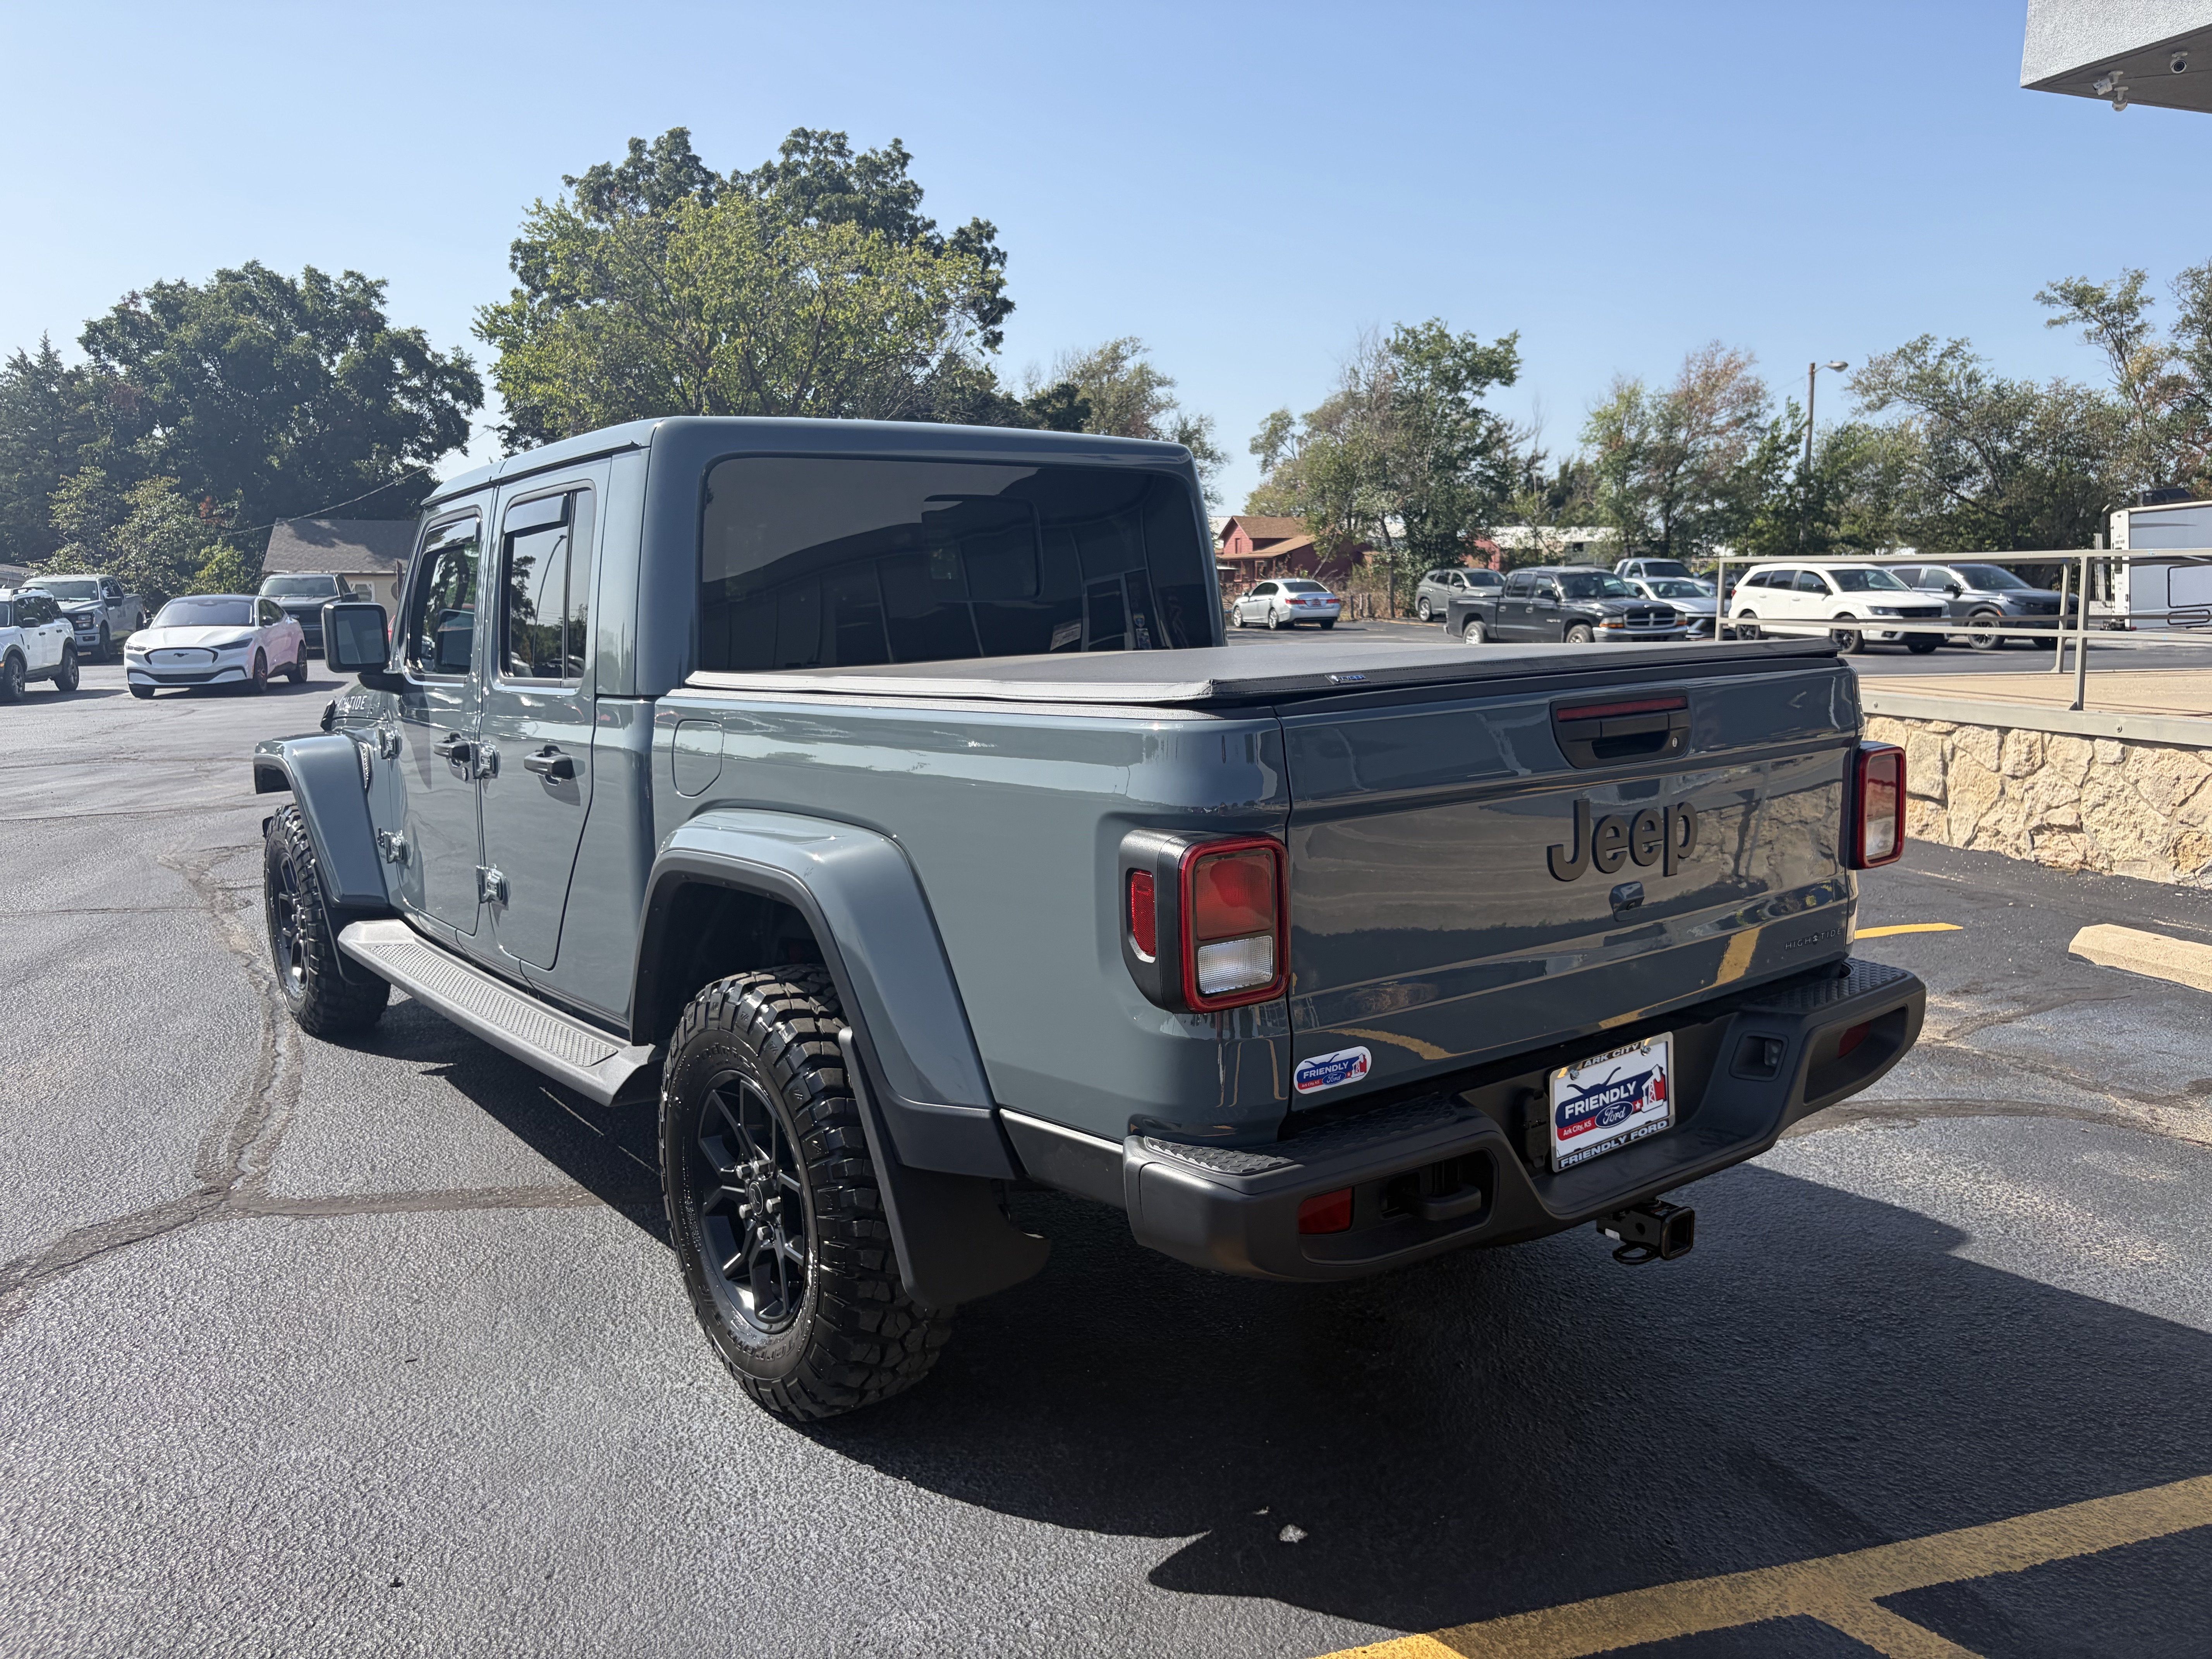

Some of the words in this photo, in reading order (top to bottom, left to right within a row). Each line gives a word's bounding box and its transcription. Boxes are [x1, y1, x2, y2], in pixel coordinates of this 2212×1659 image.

[350, 695, 368, 710] TIDE
[1547, 798, 1698, 882] Jeep
[1785, 936, 1811, 950] HIGH
[1820, 927, 1842, 939] TIDE
[1583, 1054, 1609, 1068] ARK
[1612, 1043, 1639, 1058] CITY
[1304, 1061, 1349, 1079] FRIENDLY
[1326, 1073, 1341, 1084] Ford
[1565, 1081, 1637, 1120] FRIENDLY
[1602, 1105, 1626, 1125] Ford
[1572, 1124, 1584, 1133] City,
[1584, 1120, 1592, 1128] KS
[1561, 1135, 1628, 1168] FRIENDLY
[1630, 1120, 1668, 1140] FORD
